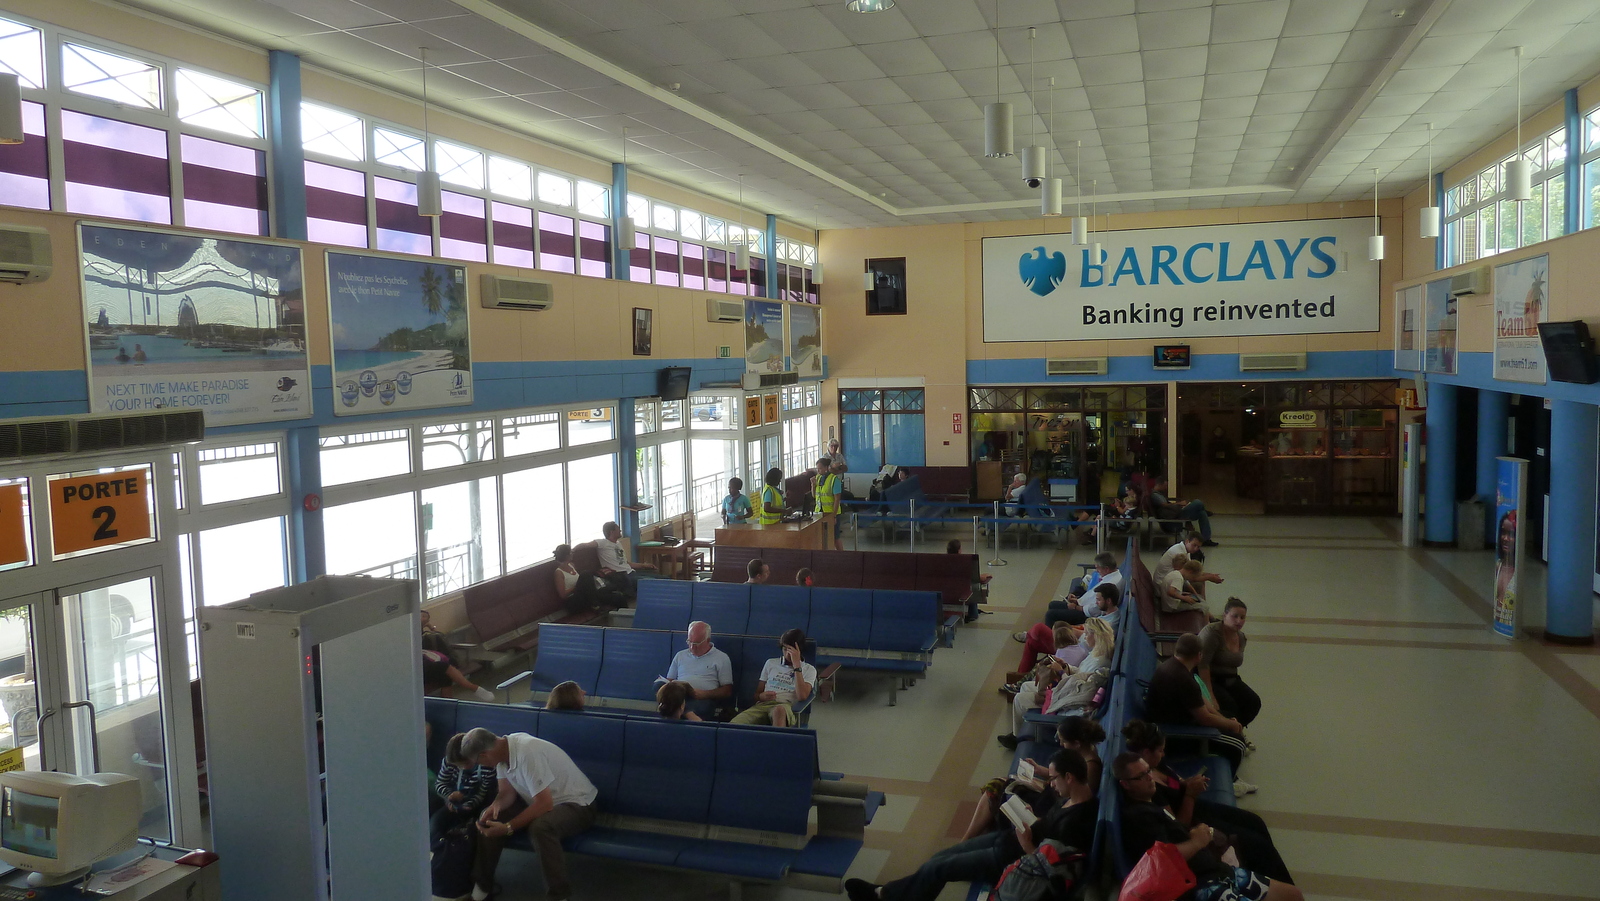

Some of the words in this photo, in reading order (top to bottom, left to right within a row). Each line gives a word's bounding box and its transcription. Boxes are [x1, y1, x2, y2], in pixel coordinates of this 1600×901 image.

[1080, 236, 1337, 288] BARCLAYS
[1082, 302, 1184, 328] Banking
[1193, 295, 1336, 322] reinvented
[106, 383, 136, 396] NEXT
[139, 382, 165, 395] TIME
[168, 380, 199, 393] MAKE
[202, 378, 249, 392] PARADISE
[107, 398, 142, 411] YOUR
[144, 396, 179, 410] HOME
[181, 393, 230, 407] FOREVER!
[748, 400, 758, 408] GATE
[765, 397, 777, 405] PORTE
[751, 409, 756, 423] 3
[769, 406, 774, 420] 3
[63, 477, 138, 503] PORTE
[92, 506, 118, 541] 2
